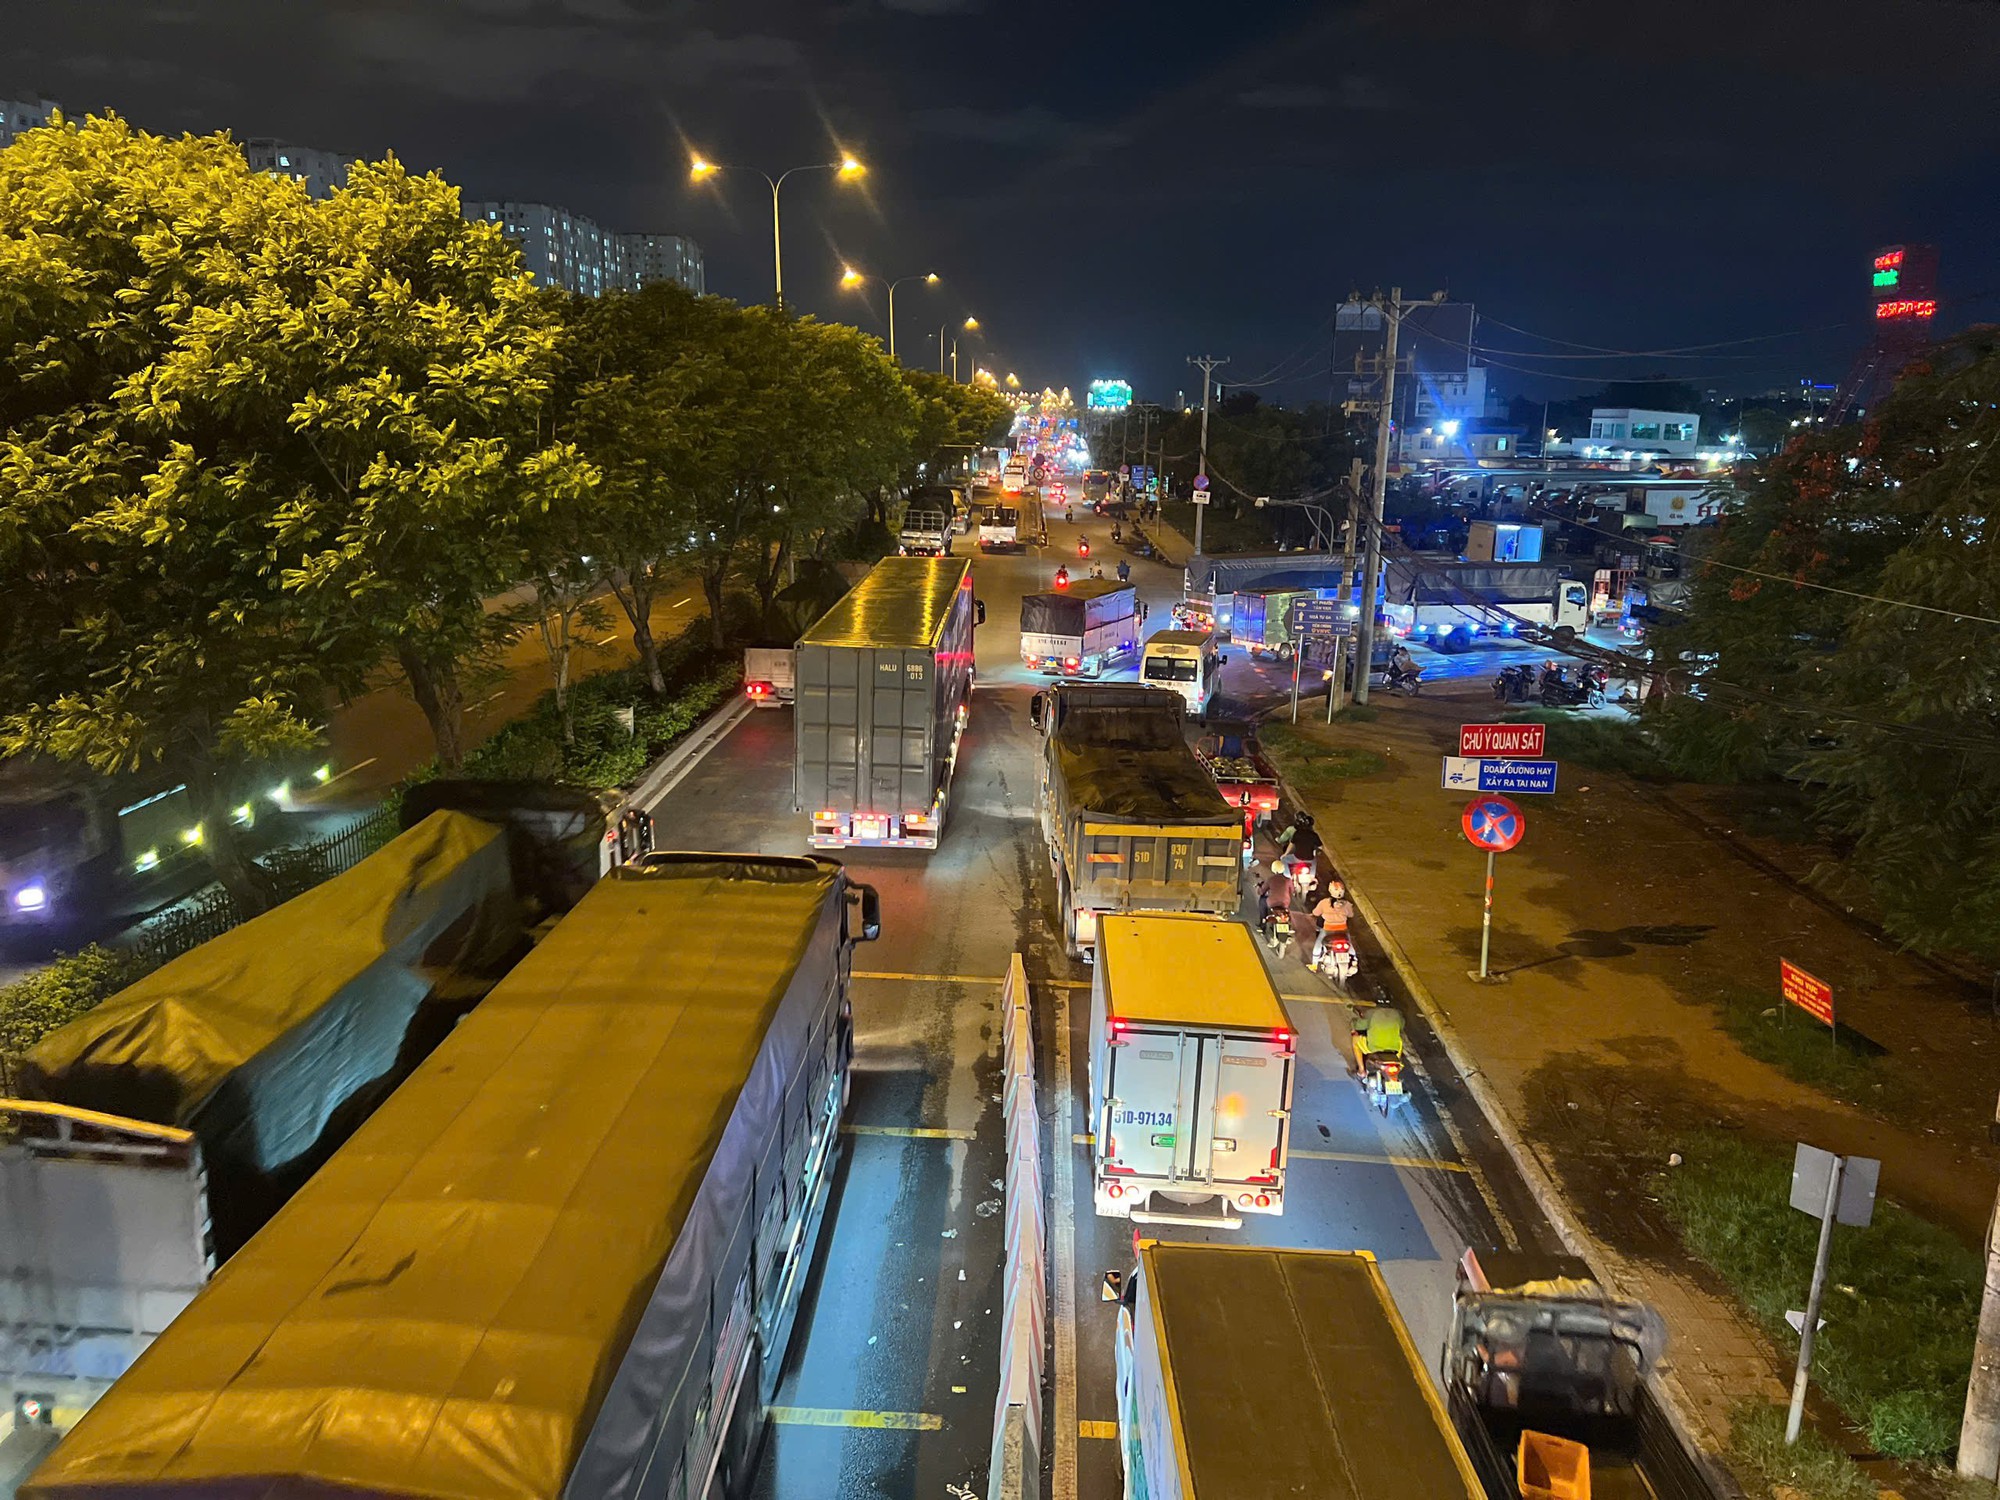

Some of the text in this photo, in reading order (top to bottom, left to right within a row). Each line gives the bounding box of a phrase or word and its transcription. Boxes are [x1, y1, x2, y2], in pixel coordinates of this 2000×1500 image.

[880, 664, 897, 672] HALU
[1463, 727, 1541, 750] CHÚ Ý QUAN SÁT
[1536, 767, 1552, 775] HAY
[1486, 776, 1502, 786] XẢY
[1503, 779, 1515, 787] RA
[1170, 844, 1187, 855] 930
[1134, 851, 1150, 863] 51D
[1173, 858, 1184, 870] 74
[1114, 1110, 1172, 1127] 51D-971.34
